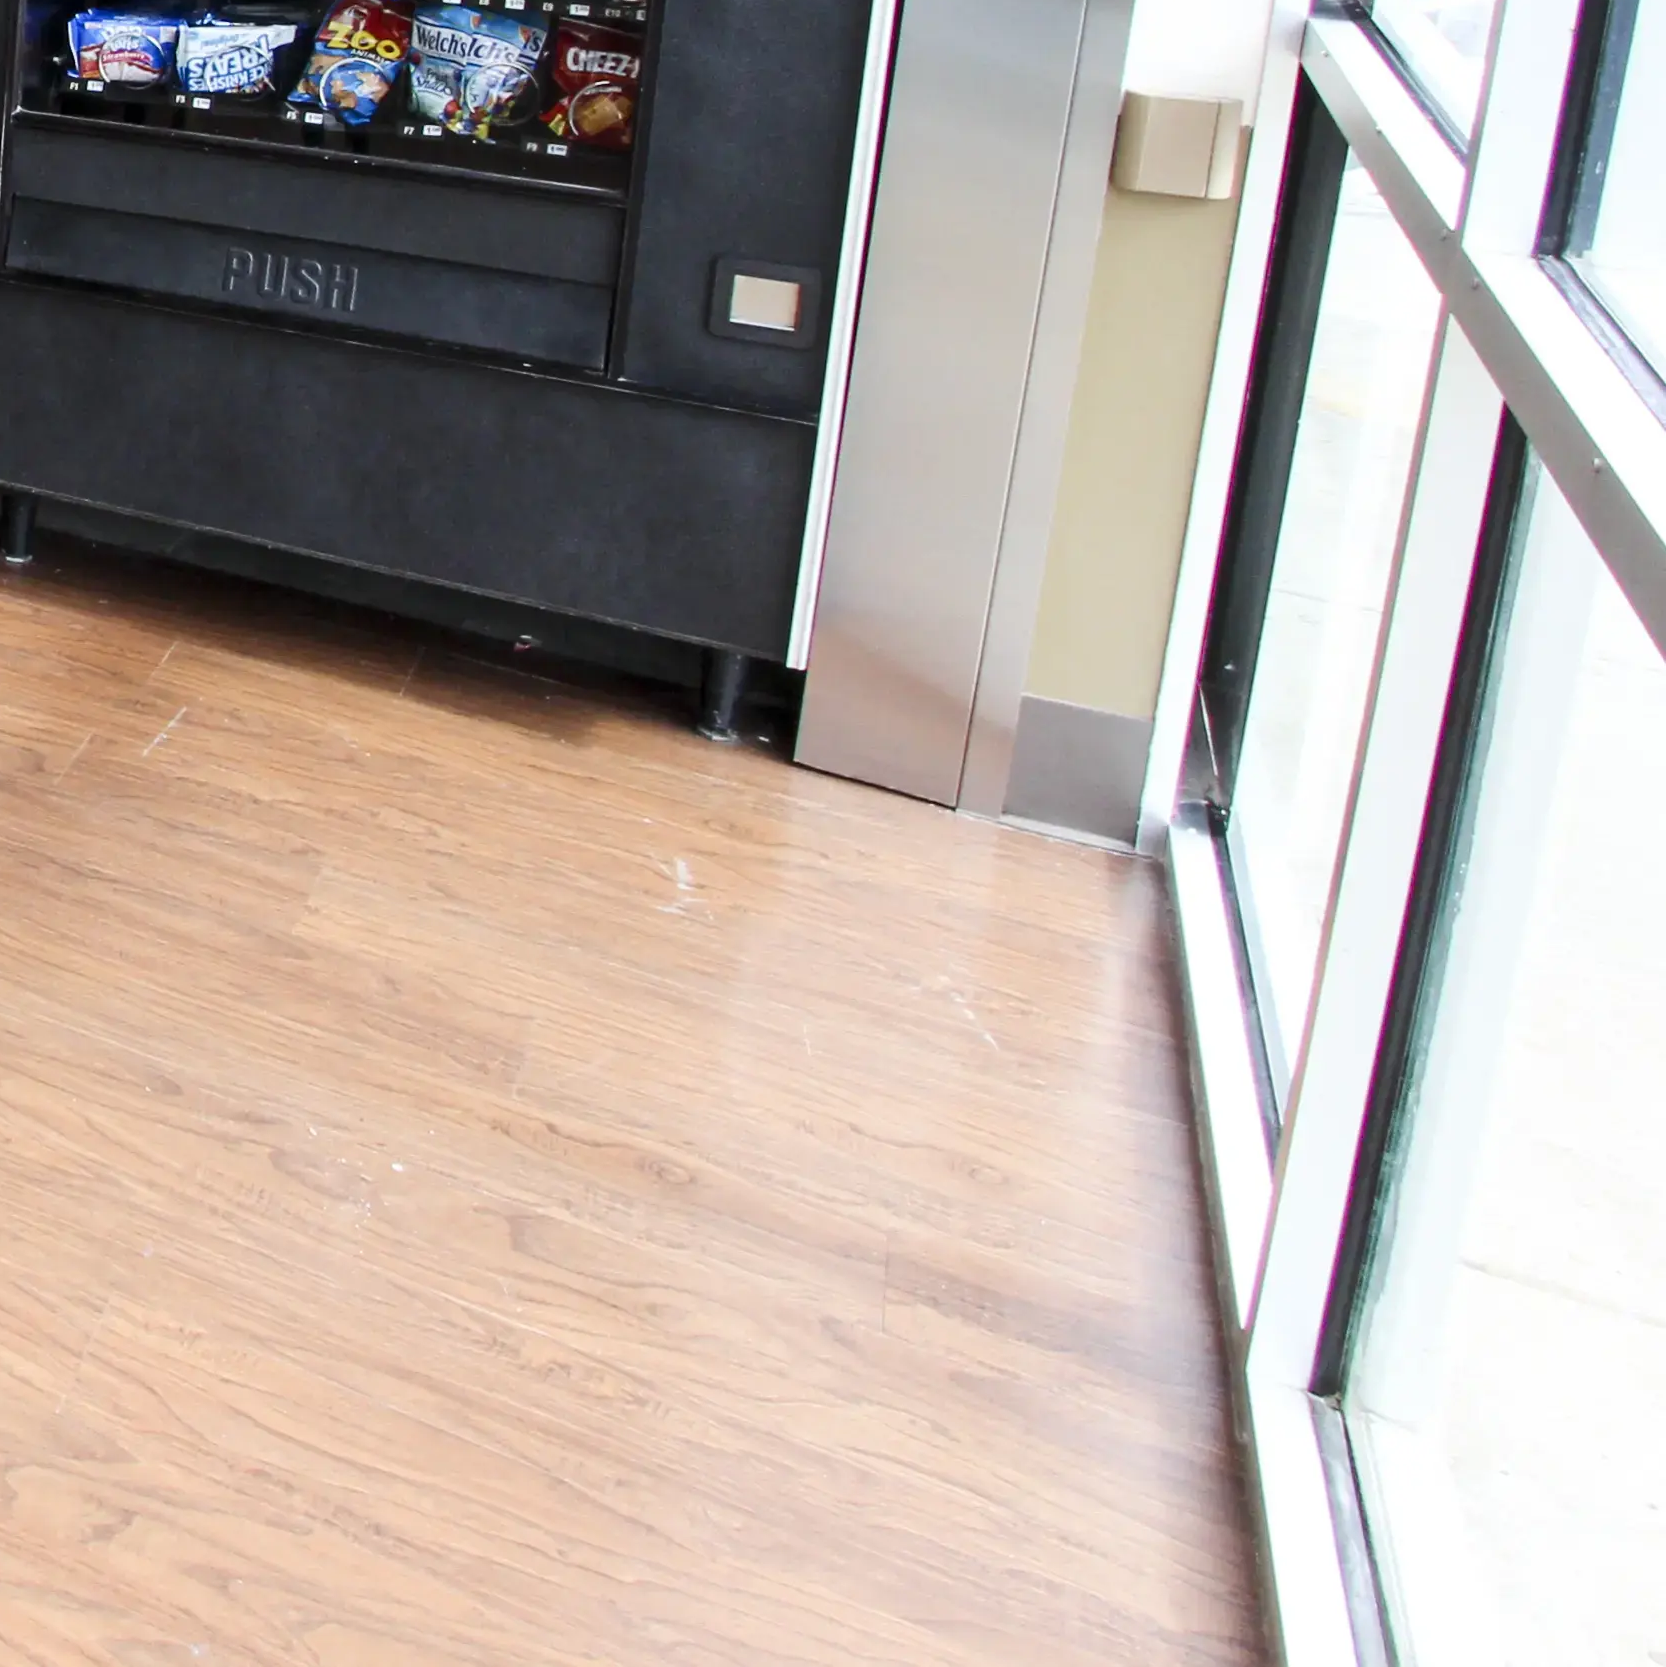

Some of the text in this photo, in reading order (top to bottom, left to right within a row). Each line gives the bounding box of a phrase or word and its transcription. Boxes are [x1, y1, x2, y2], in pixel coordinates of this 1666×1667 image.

[327, 21, 401, 59] ZOO
[417, 22, 467, 58] Welch's
[222, 246, 359, 312] PUSH
